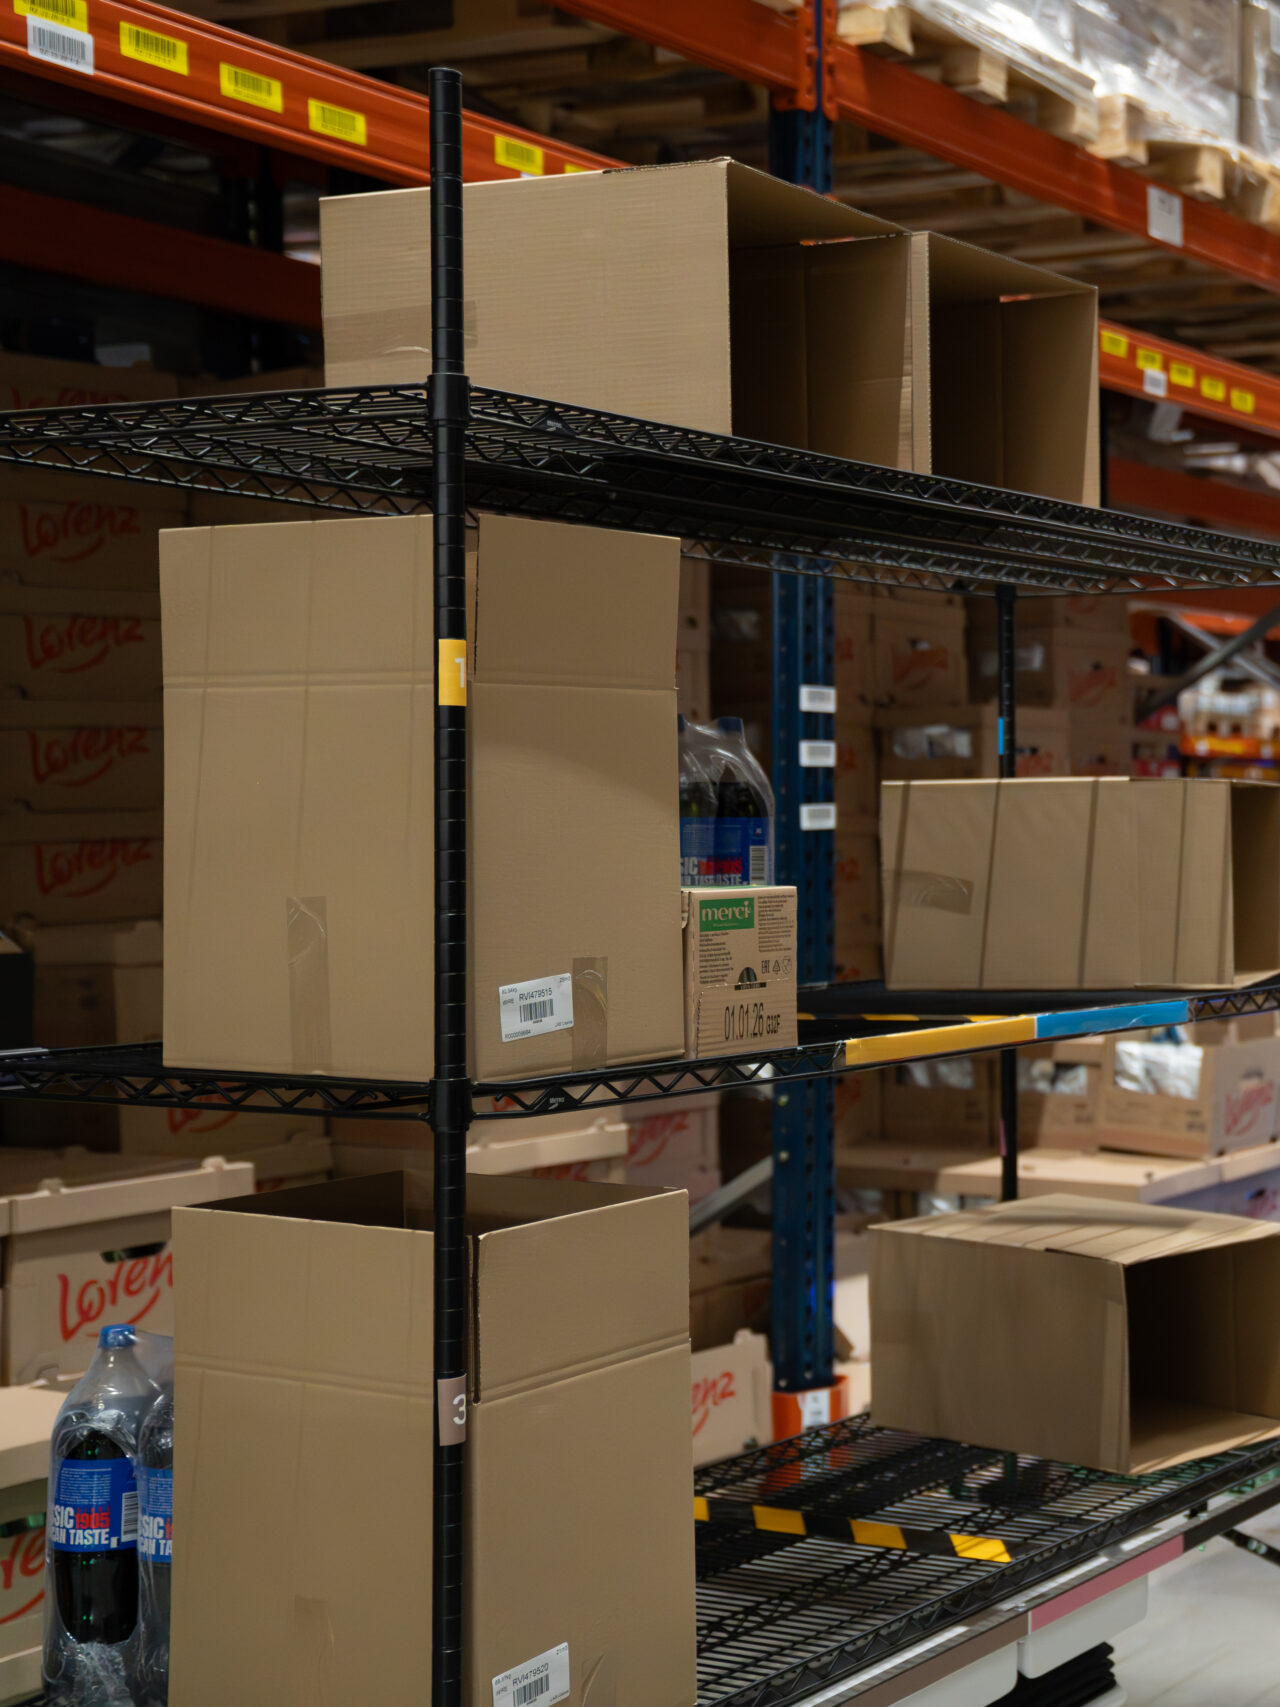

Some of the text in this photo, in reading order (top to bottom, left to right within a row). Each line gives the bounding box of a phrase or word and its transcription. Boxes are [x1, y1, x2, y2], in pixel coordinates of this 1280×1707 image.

[19, 500, 141, 560] Lorenz
[22, 615, 145, 671] Lorenz
[454, 657, 465, 688] 1
[27, 726, 150, 785] Lorenz
[34, 838, 153, 896] Lorenz
[702, 901, 750, 921] merci
[724, 1002, 764, 1041] 01.01.26
[452, 1393, 467, 1426] 3
[75, 1506, 110, 1530] 1905
